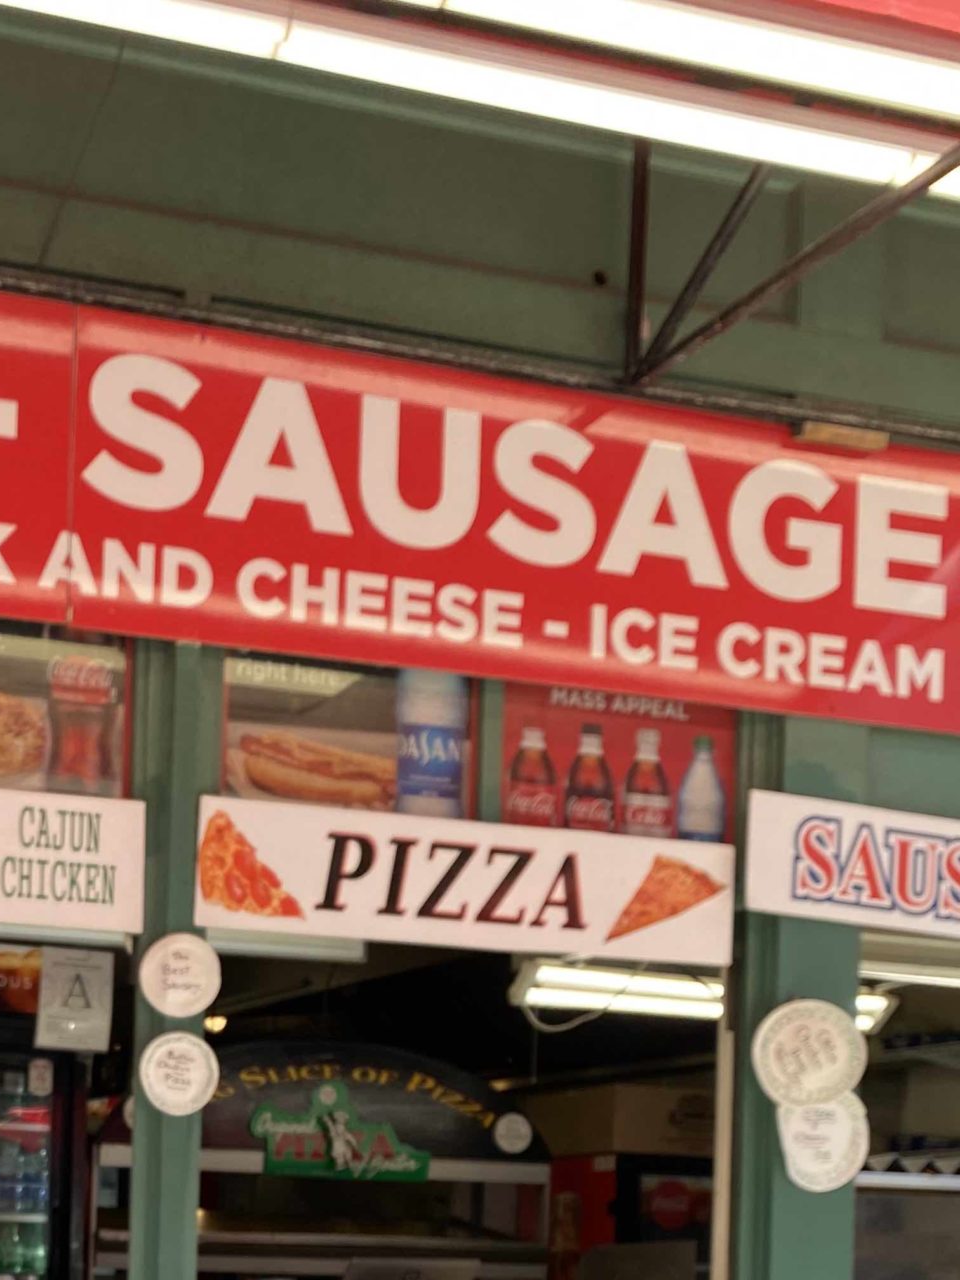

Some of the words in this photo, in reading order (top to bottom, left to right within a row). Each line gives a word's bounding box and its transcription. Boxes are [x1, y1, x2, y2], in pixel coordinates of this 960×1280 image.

[80, 352, 950, 617] SAUSAGE
[38, 529, 214, 607] AND
[237, 556, 525, 648] CHEESE
[589, 602, 700, 671] ICE
[716, 620, 945, 704] CREAM
[550, 686, 607, 711] MASS
[610, 692, 690, 722] APPEAL
[18, 806, 101, 853] CAJUN
[0, 856, 117, 905] CHICKEN
[315, 832, 589, 931] PIZZA
[61, 972, 93, 1009] A
